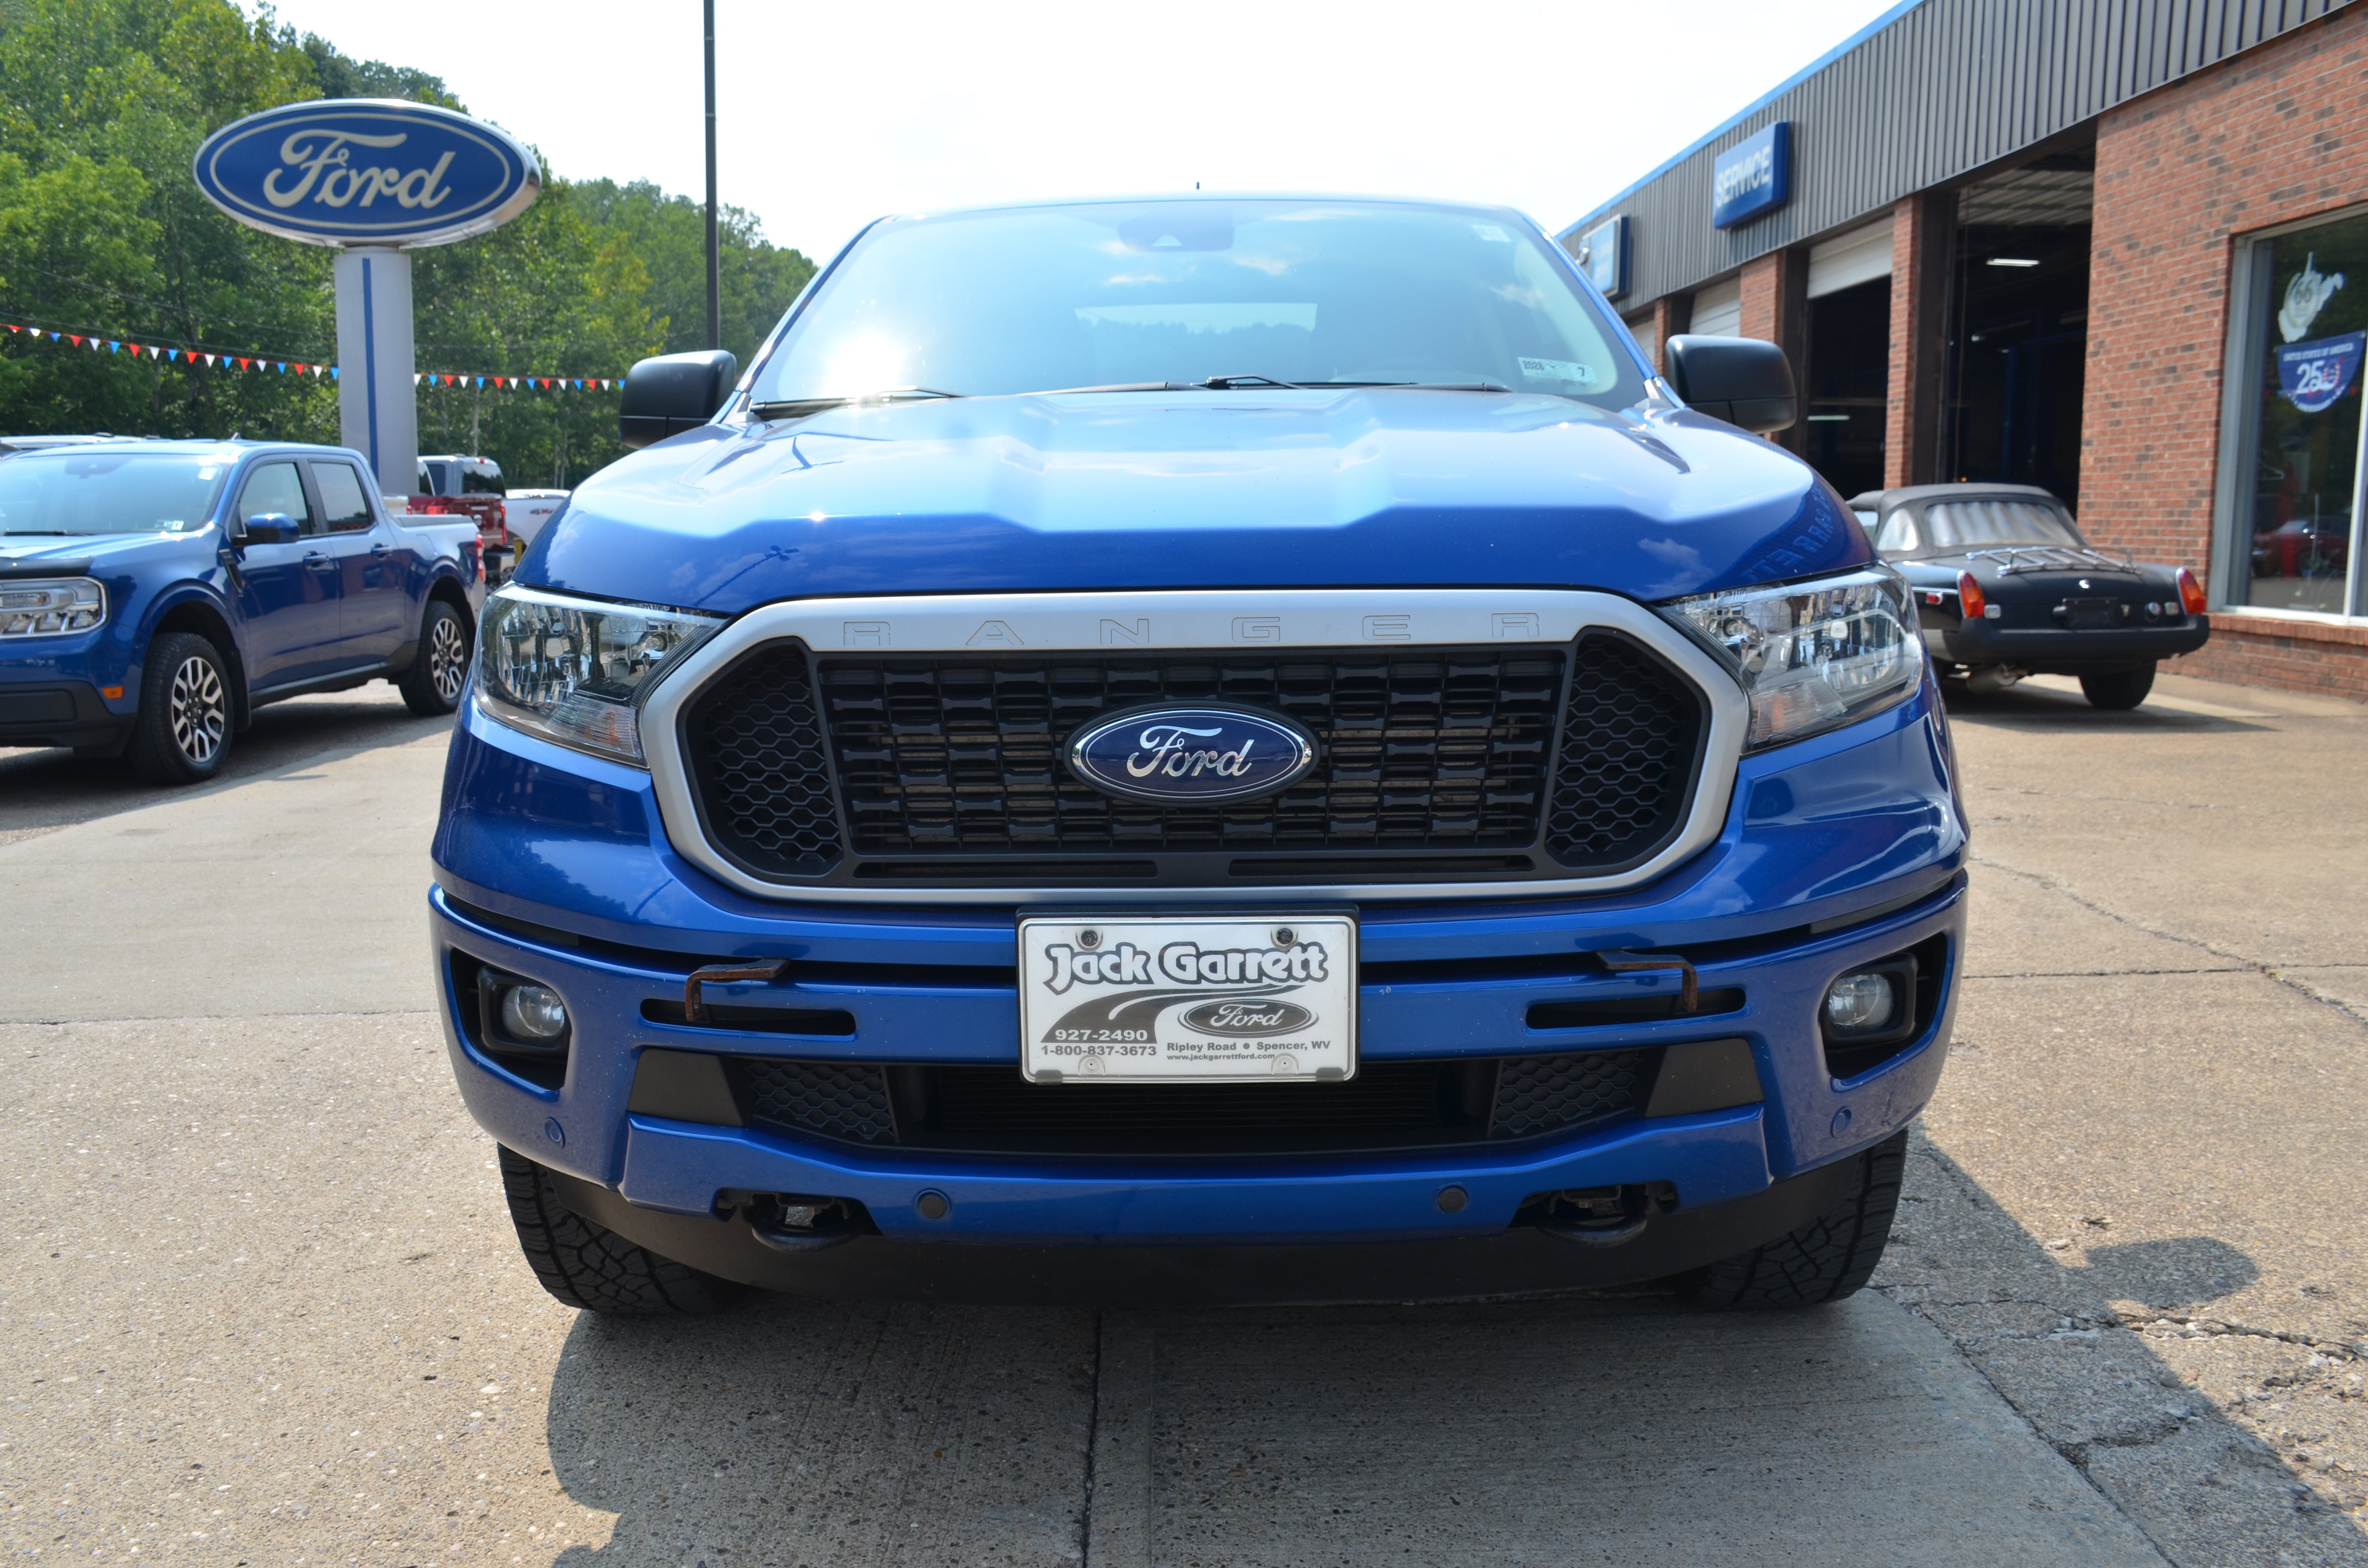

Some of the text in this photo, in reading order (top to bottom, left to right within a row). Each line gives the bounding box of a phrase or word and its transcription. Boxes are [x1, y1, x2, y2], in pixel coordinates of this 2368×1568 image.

[263, 129, 456, 209] Ford
[1716, 145, 1771, 208] SERVICE
[843, 612, 1540, 646] RANGER
[1126, 725, 1255, 777] Ford
[1043, 941, 1329, 996] Jack Garrett
[1210, 1004, 1285, 1027] Ford
[1055, 1029, 1148, 1041] 927-2490
[1167, 1041, 1331, 1053] Ripley Road Spencer, WV
[1041, 1045, 1157, 1056] 1-800-837-3673
[1167, 1053, 1275, 1062] www.jackgarrettford.com
